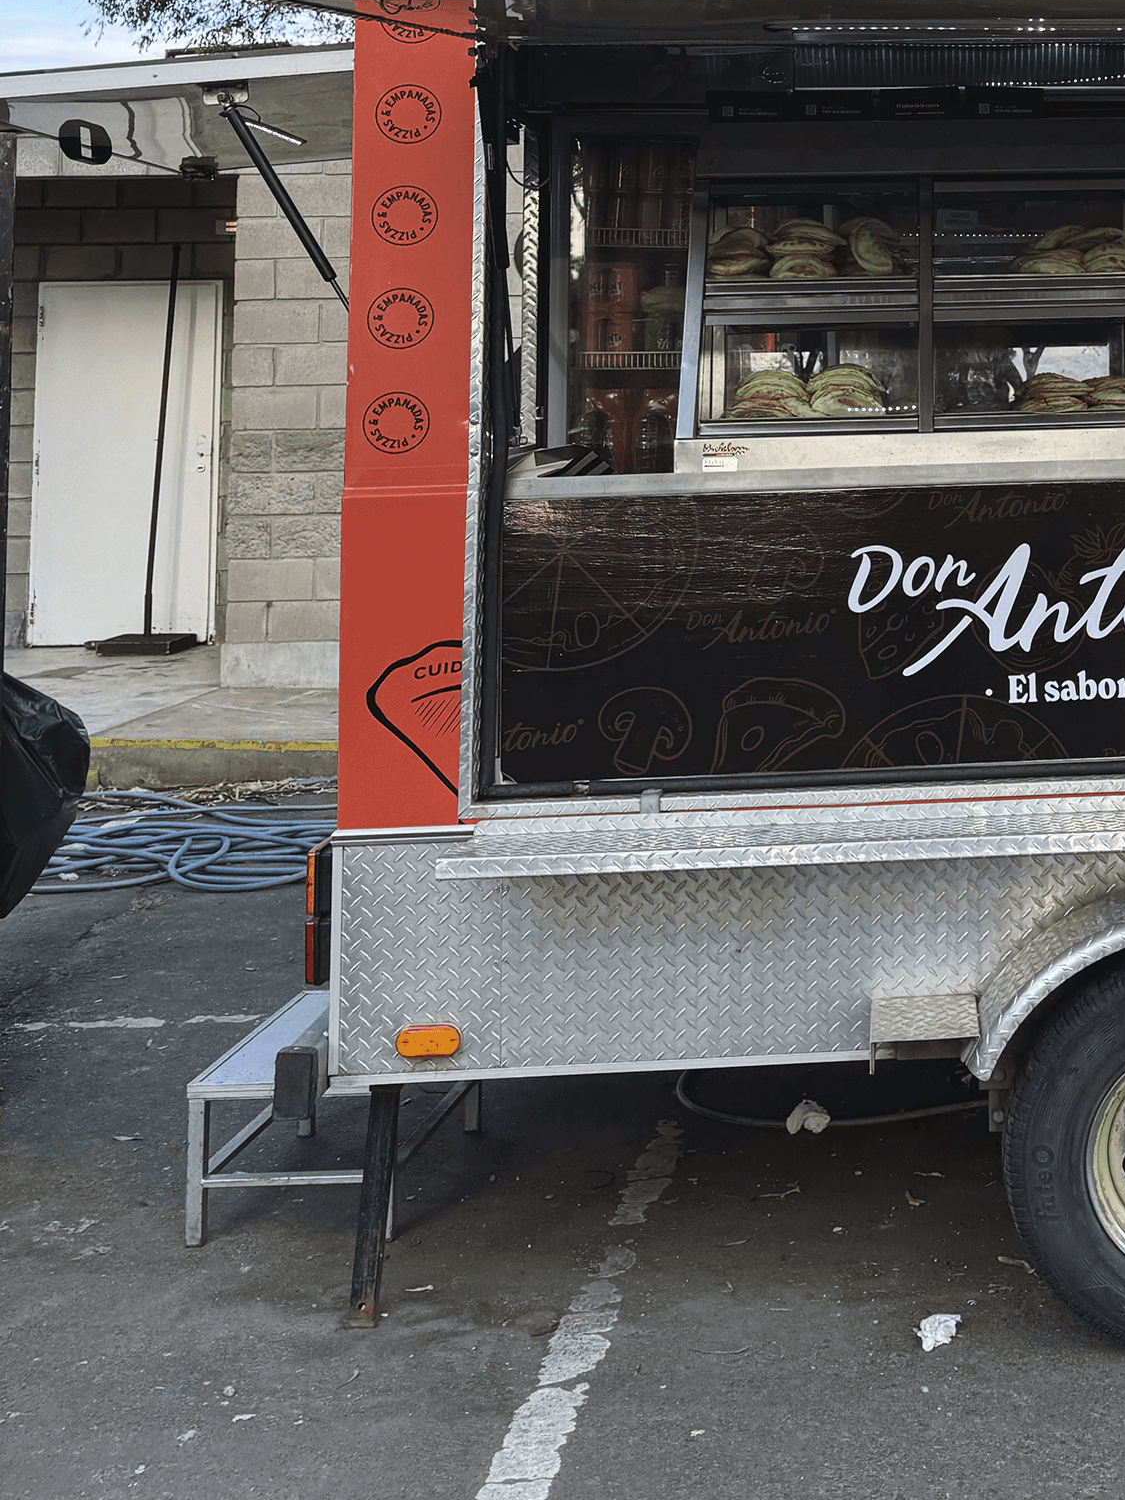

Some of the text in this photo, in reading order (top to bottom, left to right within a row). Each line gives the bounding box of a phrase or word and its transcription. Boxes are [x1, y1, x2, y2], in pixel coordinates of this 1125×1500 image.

[381, 90, 437, 140] PIZZAS & EMPANADAS
[377, 191, 433, 241] PIZZAS & EMPANADAS
[373, 293, 429, 344] PIZZAS & EMPANADAS
[369, 397, 425, 449] PIZZAS & EMPANADAS
[928, 491, 963, 510] Don
[848, 545, 976, 613] Don
[686, 611, 724, 631] Don
[1008, 673, 1038, 704] El
